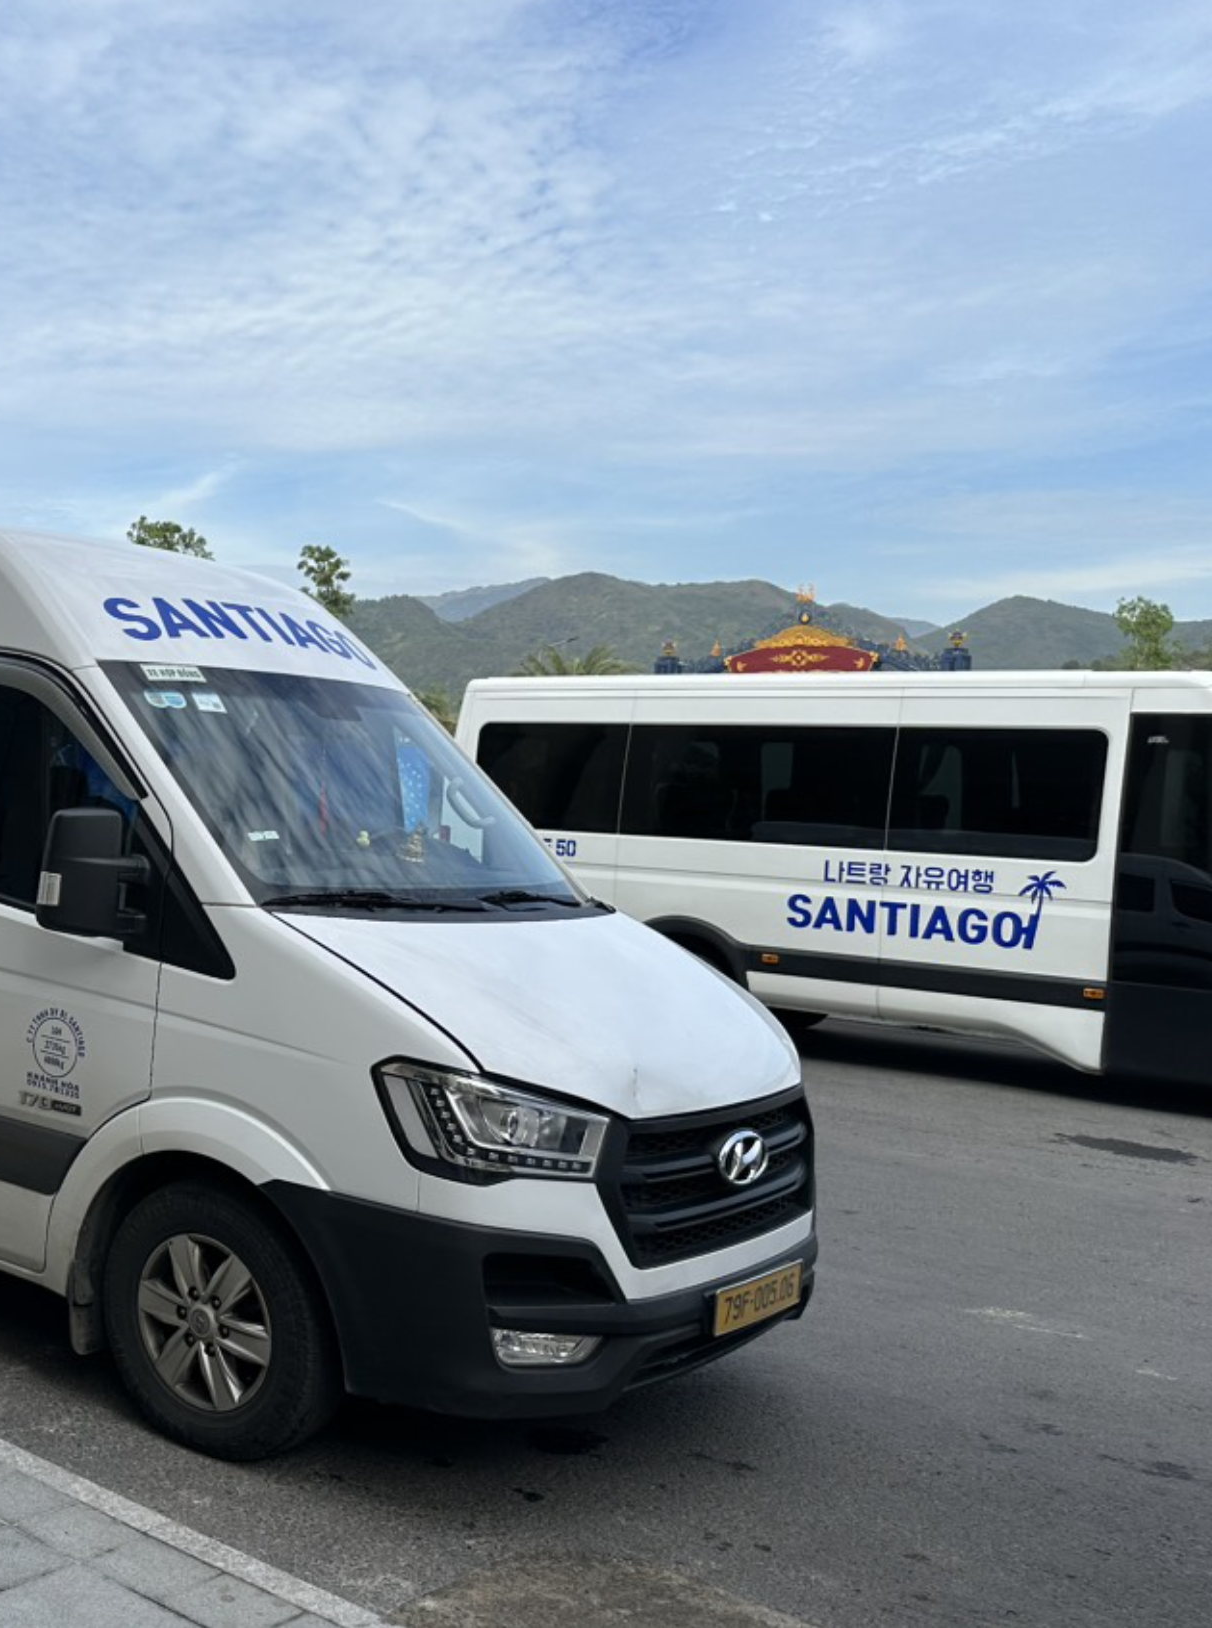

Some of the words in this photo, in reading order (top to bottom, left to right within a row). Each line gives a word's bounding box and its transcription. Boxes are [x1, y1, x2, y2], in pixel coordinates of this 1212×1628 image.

[103, 597, 377, 670] SANTIAGO
[822, 860, 891, 886] 나트랑
[899, 864, 994, 894] 자유여행
[787, 893, 1037, 949] SANTIAGO
[724, 1272, 795, 1325] 79F-005.06
